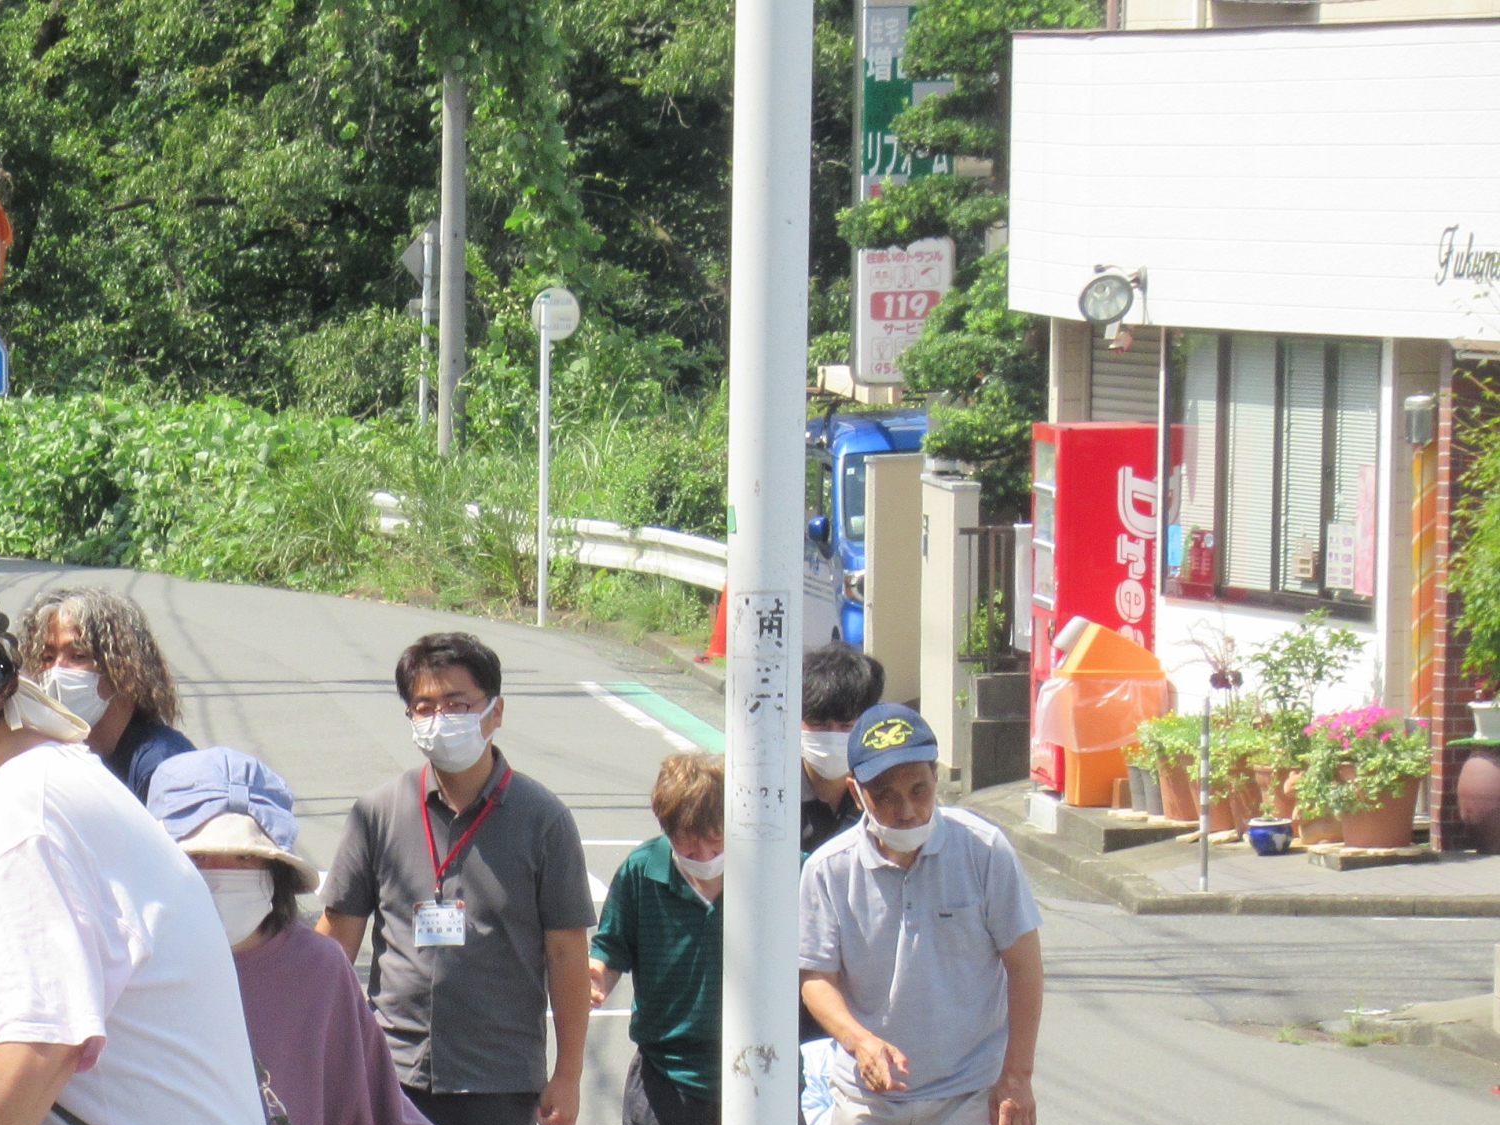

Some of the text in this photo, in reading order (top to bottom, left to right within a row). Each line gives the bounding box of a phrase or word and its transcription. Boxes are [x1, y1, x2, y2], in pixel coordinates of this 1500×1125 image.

[883, 293, 929, 319] 119
[883, 322, 924, 335] サービ
